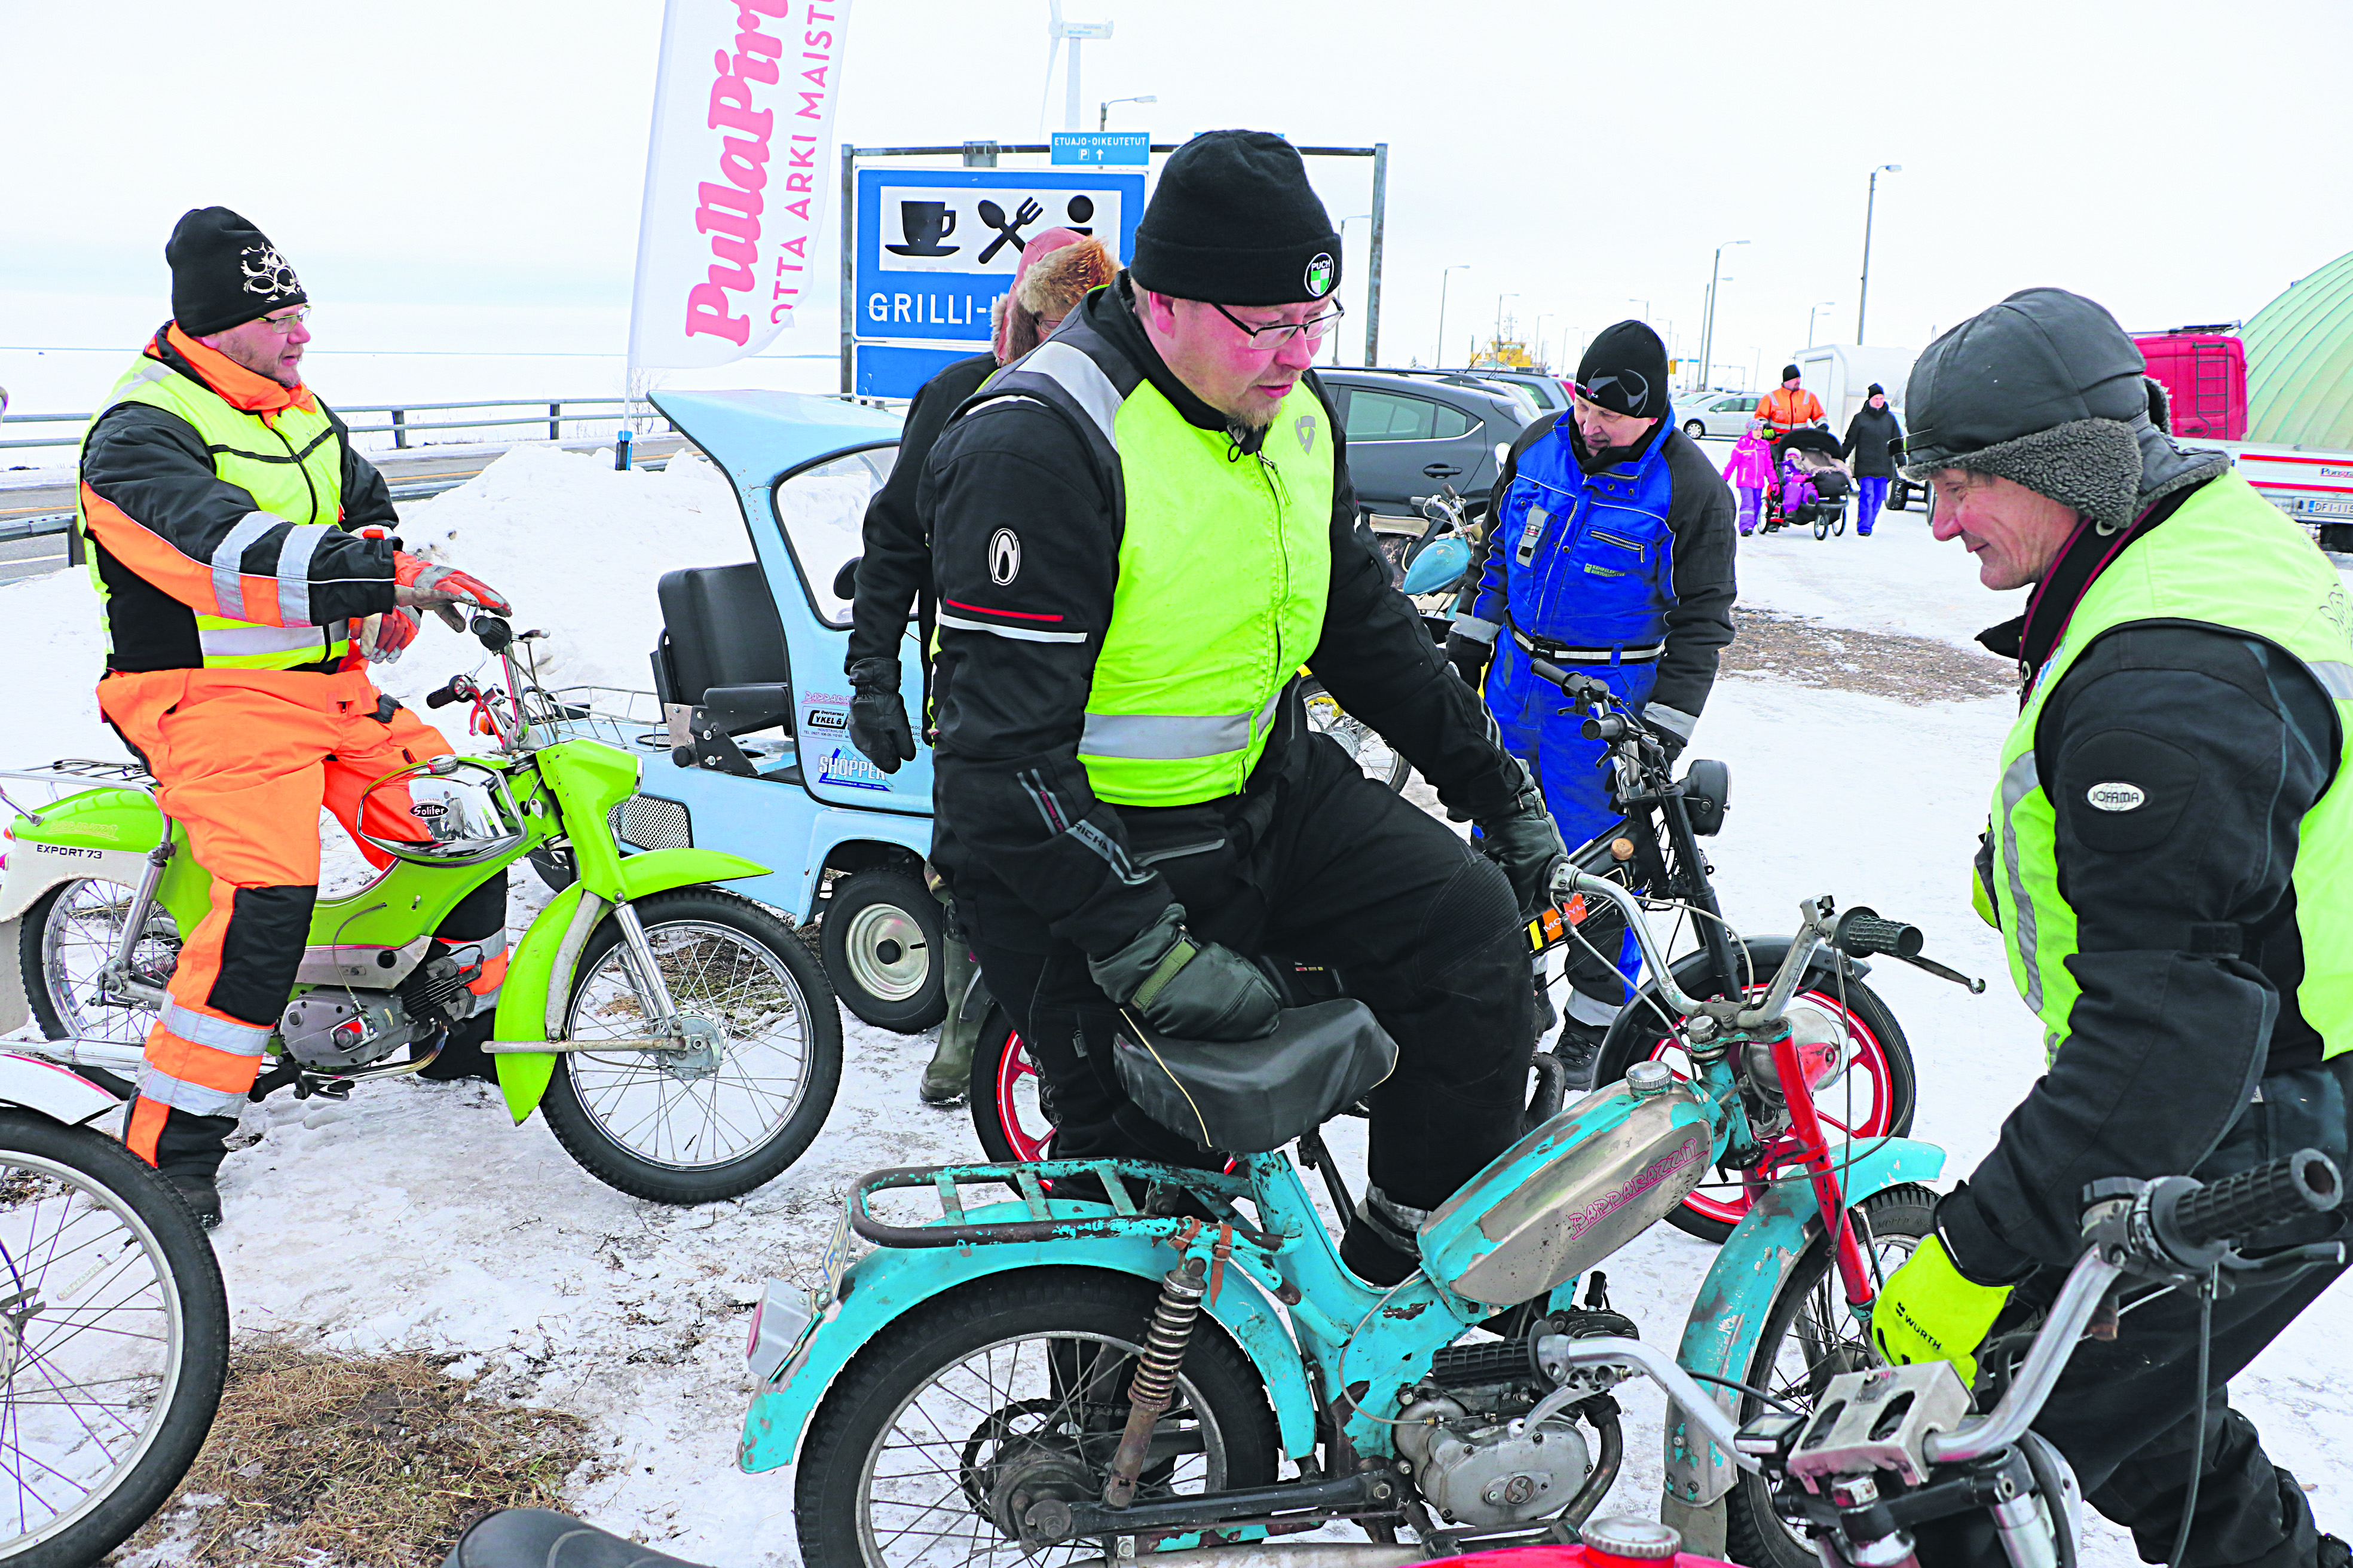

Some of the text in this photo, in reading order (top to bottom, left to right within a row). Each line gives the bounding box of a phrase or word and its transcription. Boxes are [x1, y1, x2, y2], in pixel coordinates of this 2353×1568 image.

[794, 0, 835, 120] MAIST
[1054, 137, 1146, 145] ETUAJO-OIKEUTETUT
[784, 134, 816, 221] ARKI
[1311, 259, 1330, 271] PUCH
[2092, 791, 2139, 803] JOFAMA
[414, 805, 445, 816] Solifer
[36, 844, 103, 859] EXPORT 73
